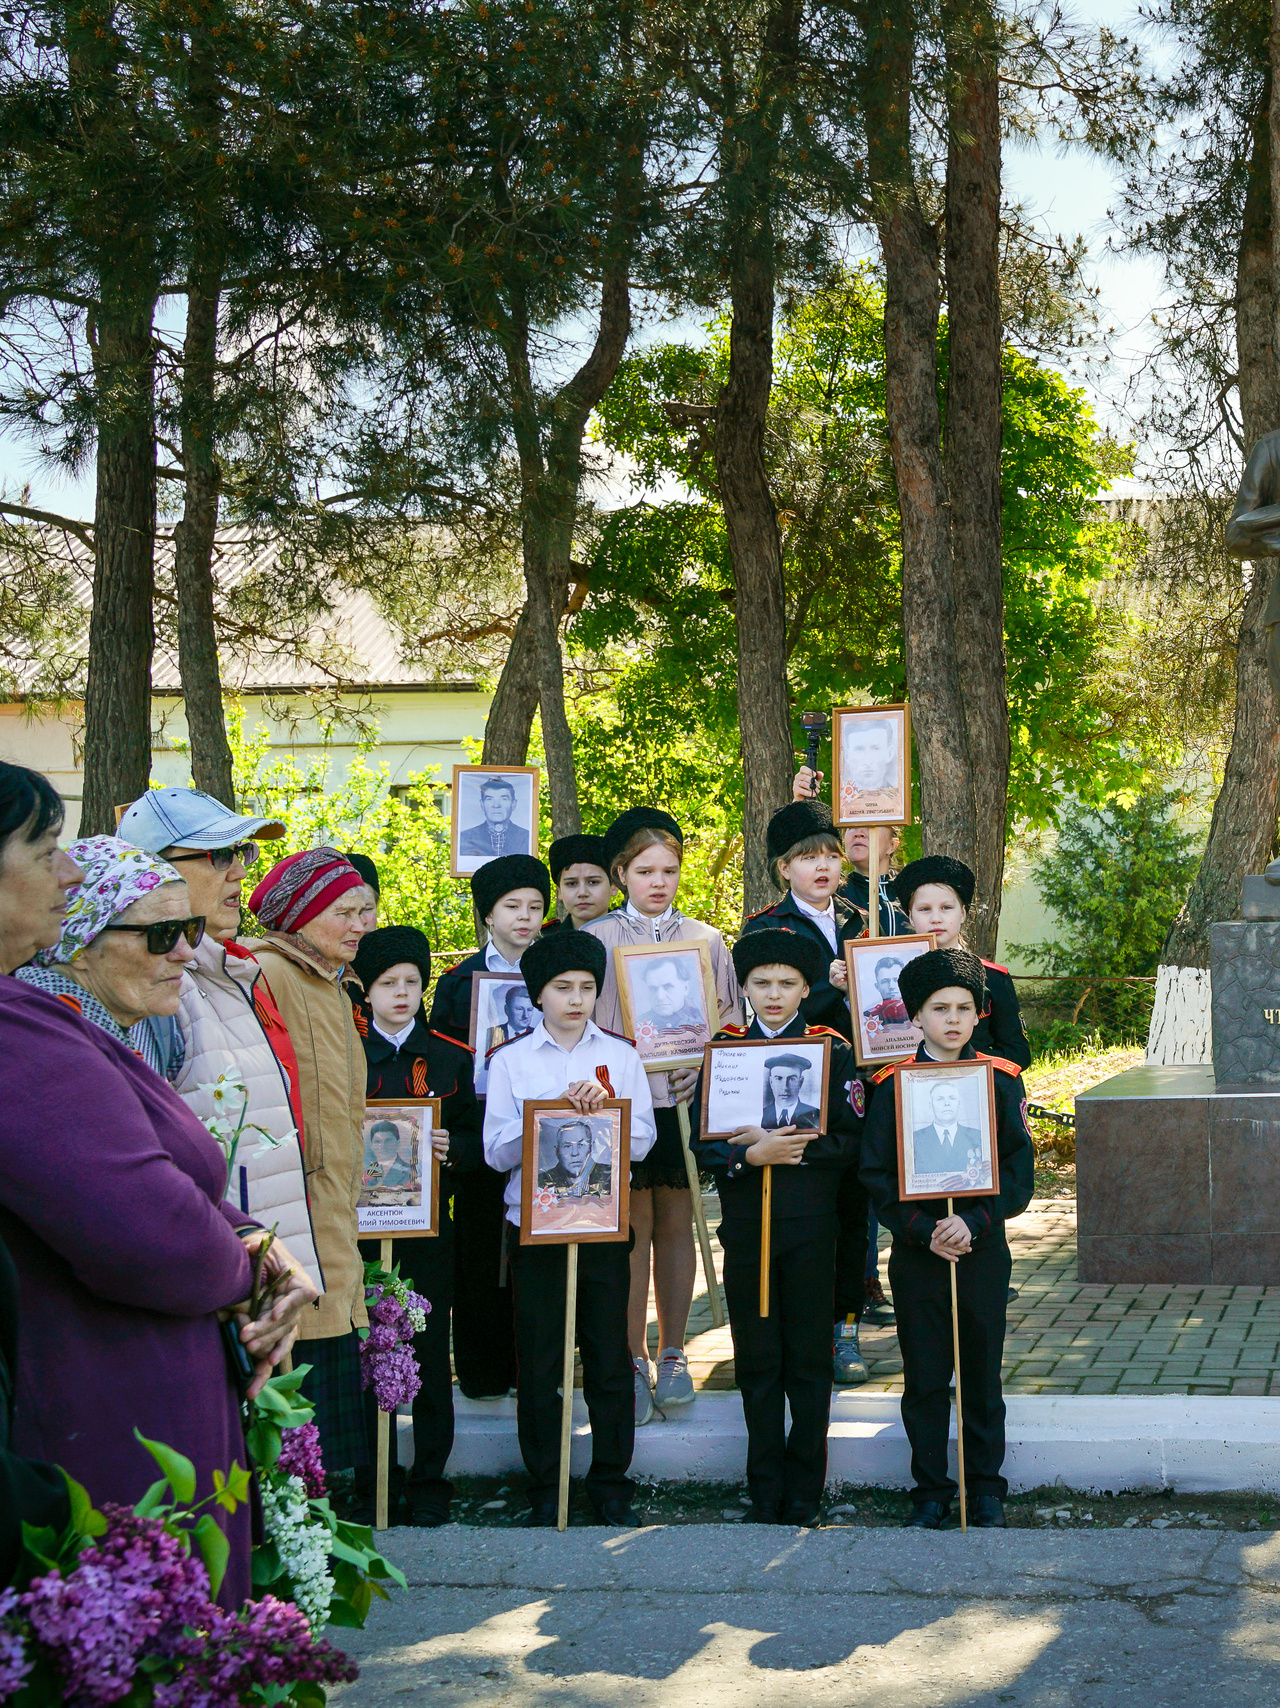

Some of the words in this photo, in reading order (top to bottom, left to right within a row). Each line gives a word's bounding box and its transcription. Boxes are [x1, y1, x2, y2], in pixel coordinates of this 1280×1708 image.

[885, 1035, 915, 1043] АПАЛЬКОВ
[871, 1044, 895, 1052] МОИСЕЙ
[367, 1209, 404, 1217] АКСЕНТЮК
[379, 1218, 426, 1227] ТИМОФЕЕВИЧ
